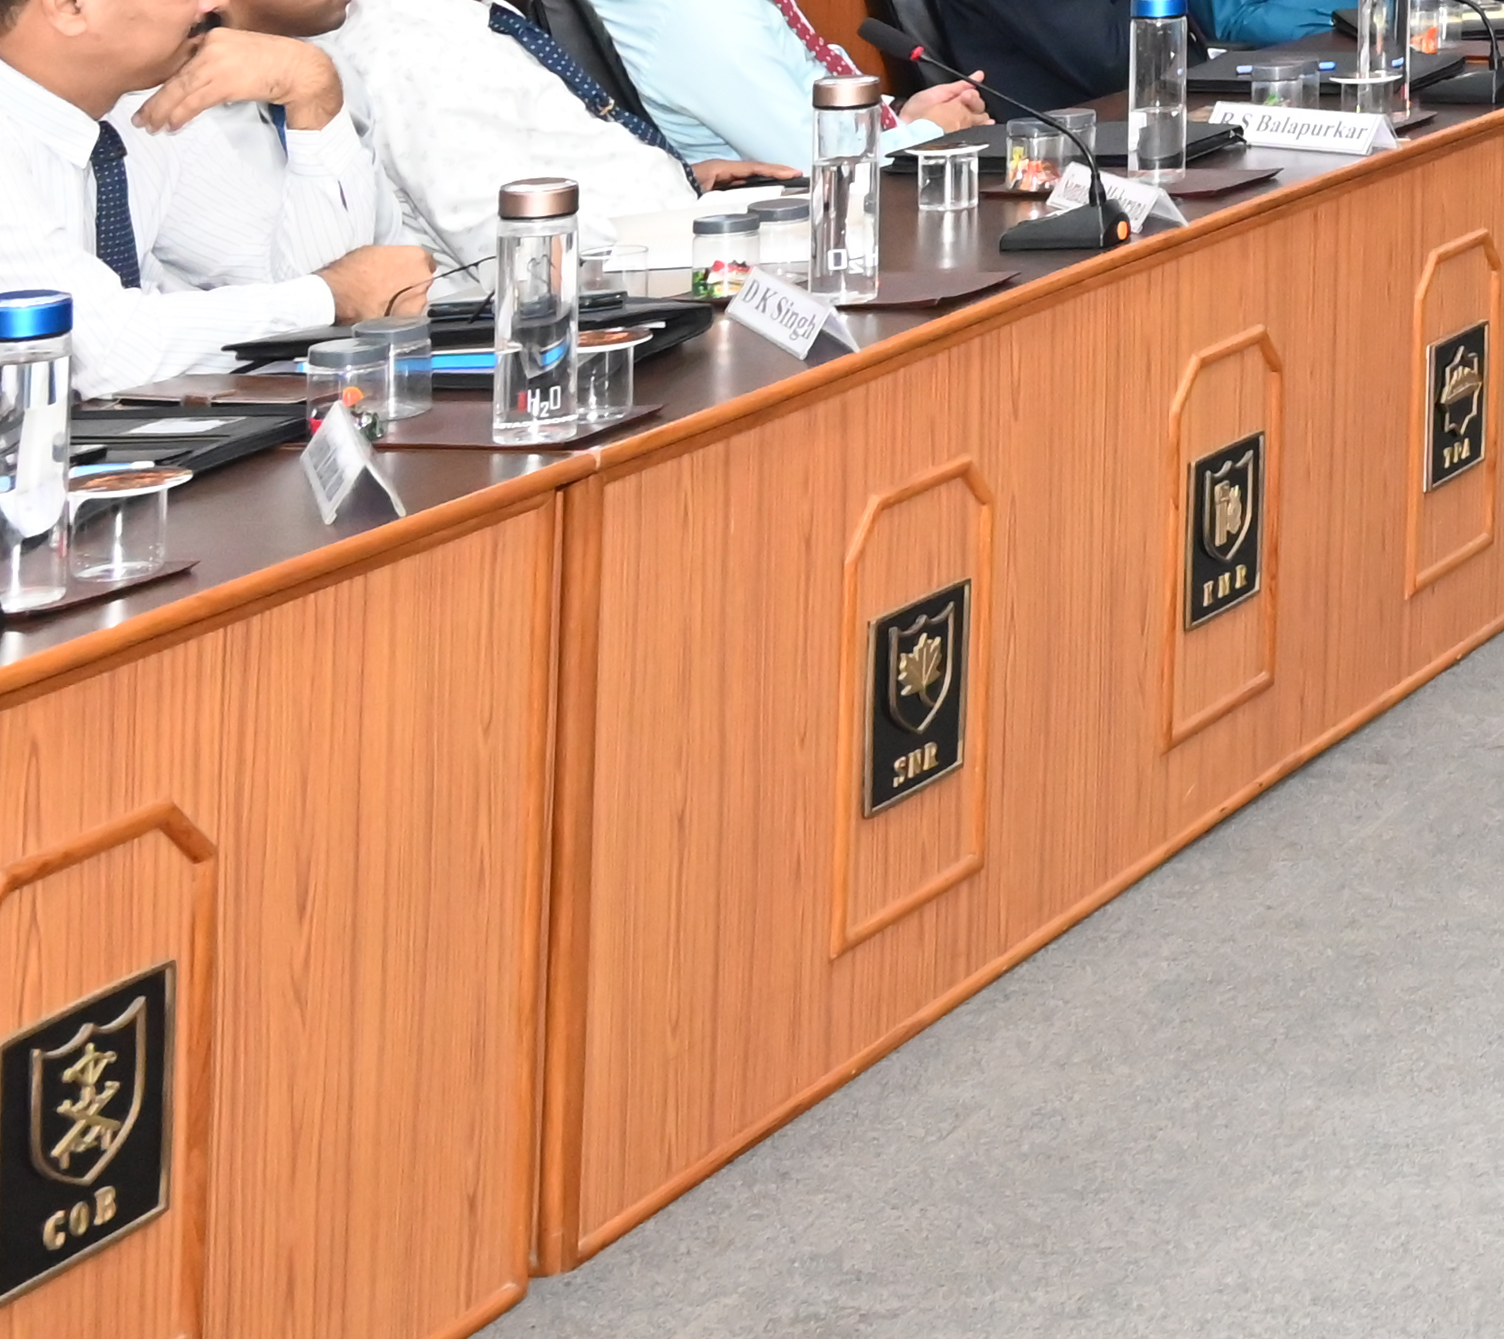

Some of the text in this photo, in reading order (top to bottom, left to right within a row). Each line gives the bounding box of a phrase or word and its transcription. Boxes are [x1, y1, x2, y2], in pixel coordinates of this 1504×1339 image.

[1241, 112, 1253, 133] S
[1256, 114, 1369, 144] Balapurkar
[742, 280, 816, 341] D K Singh
[43, 1185, 117, 1251] COB
